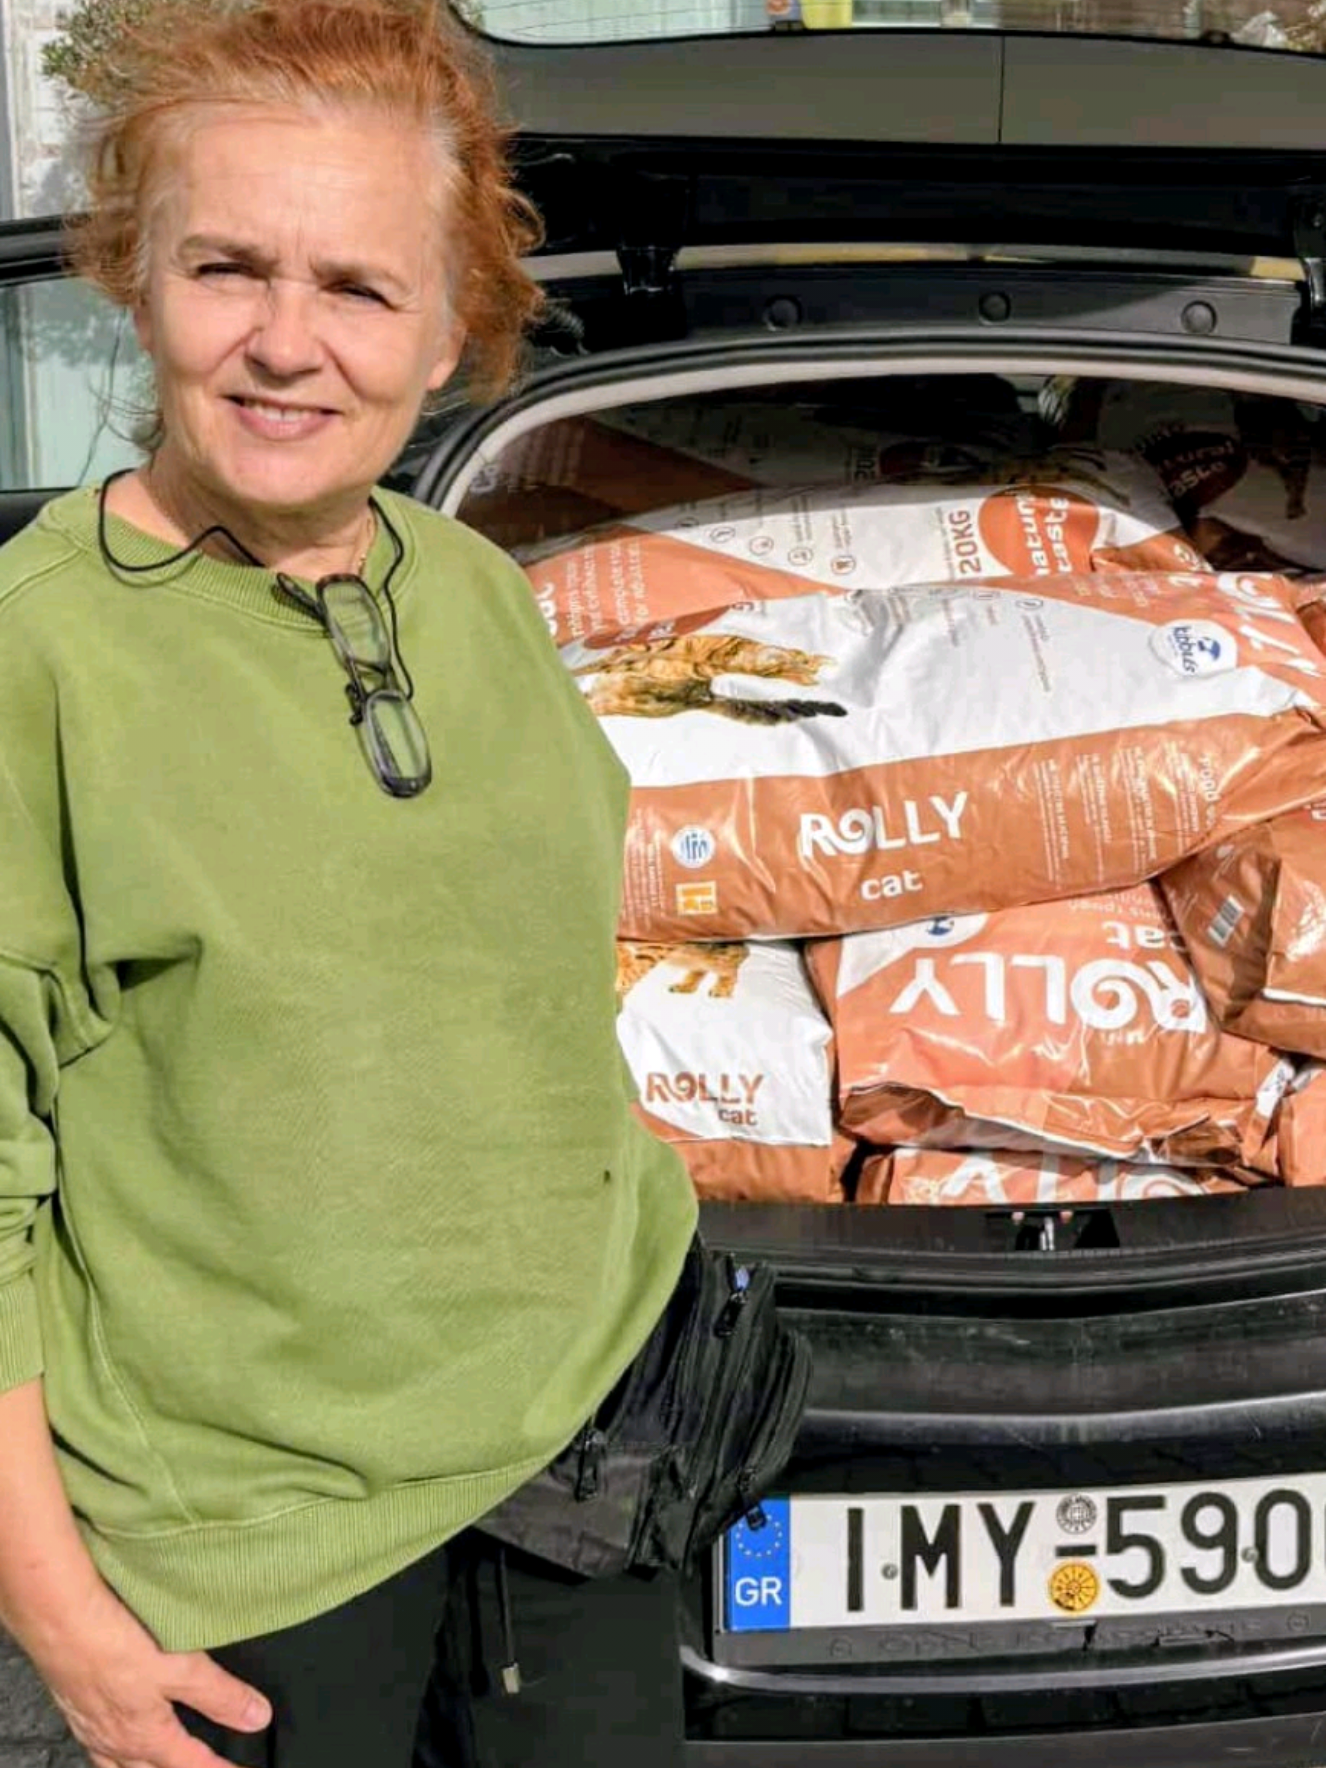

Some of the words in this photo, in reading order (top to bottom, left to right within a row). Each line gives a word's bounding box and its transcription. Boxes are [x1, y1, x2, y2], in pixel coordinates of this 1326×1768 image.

[1168, 461, 1227, 500] aste
[948, 509, 982, 574] 20KG
[798, 790, 968, 861] ROLLY
[860, 869, 923, 901] cat
[1101, 919, 1178, 951] at
[889, 951, 1208, 1034] ROLLY
[645, 1070, 765, 1105] ROLLY
[717, 1106, 758, 1127] cat
[846, 1487, 1326, 1613] IMY-590
[734, 1576, 784, 1607] GR
